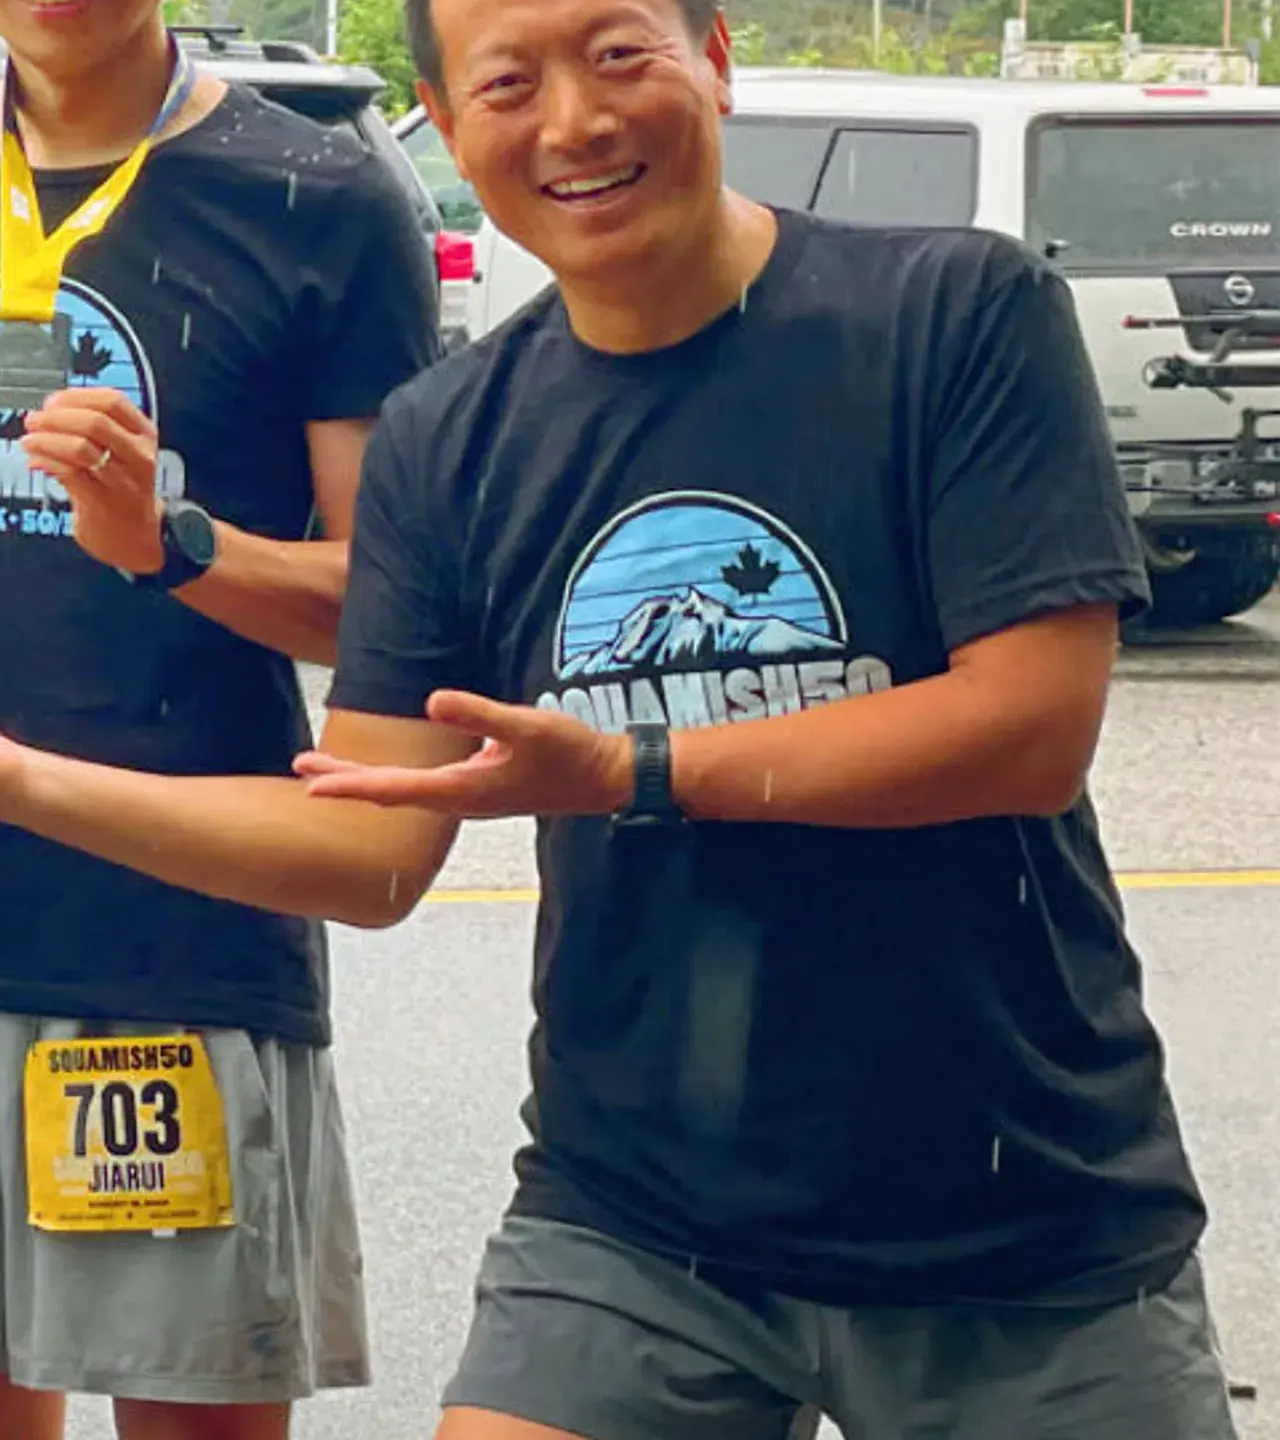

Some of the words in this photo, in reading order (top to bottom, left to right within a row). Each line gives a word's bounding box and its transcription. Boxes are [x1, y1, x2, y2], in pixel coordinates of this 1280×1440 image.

[1169, 221, 1271, 237] CROWN
[48, 1044, 194, 1073] SQUAMISH50
[63, 1079, 181, 1157] 703
[88, 1162, 165, 1193] JIARUI
